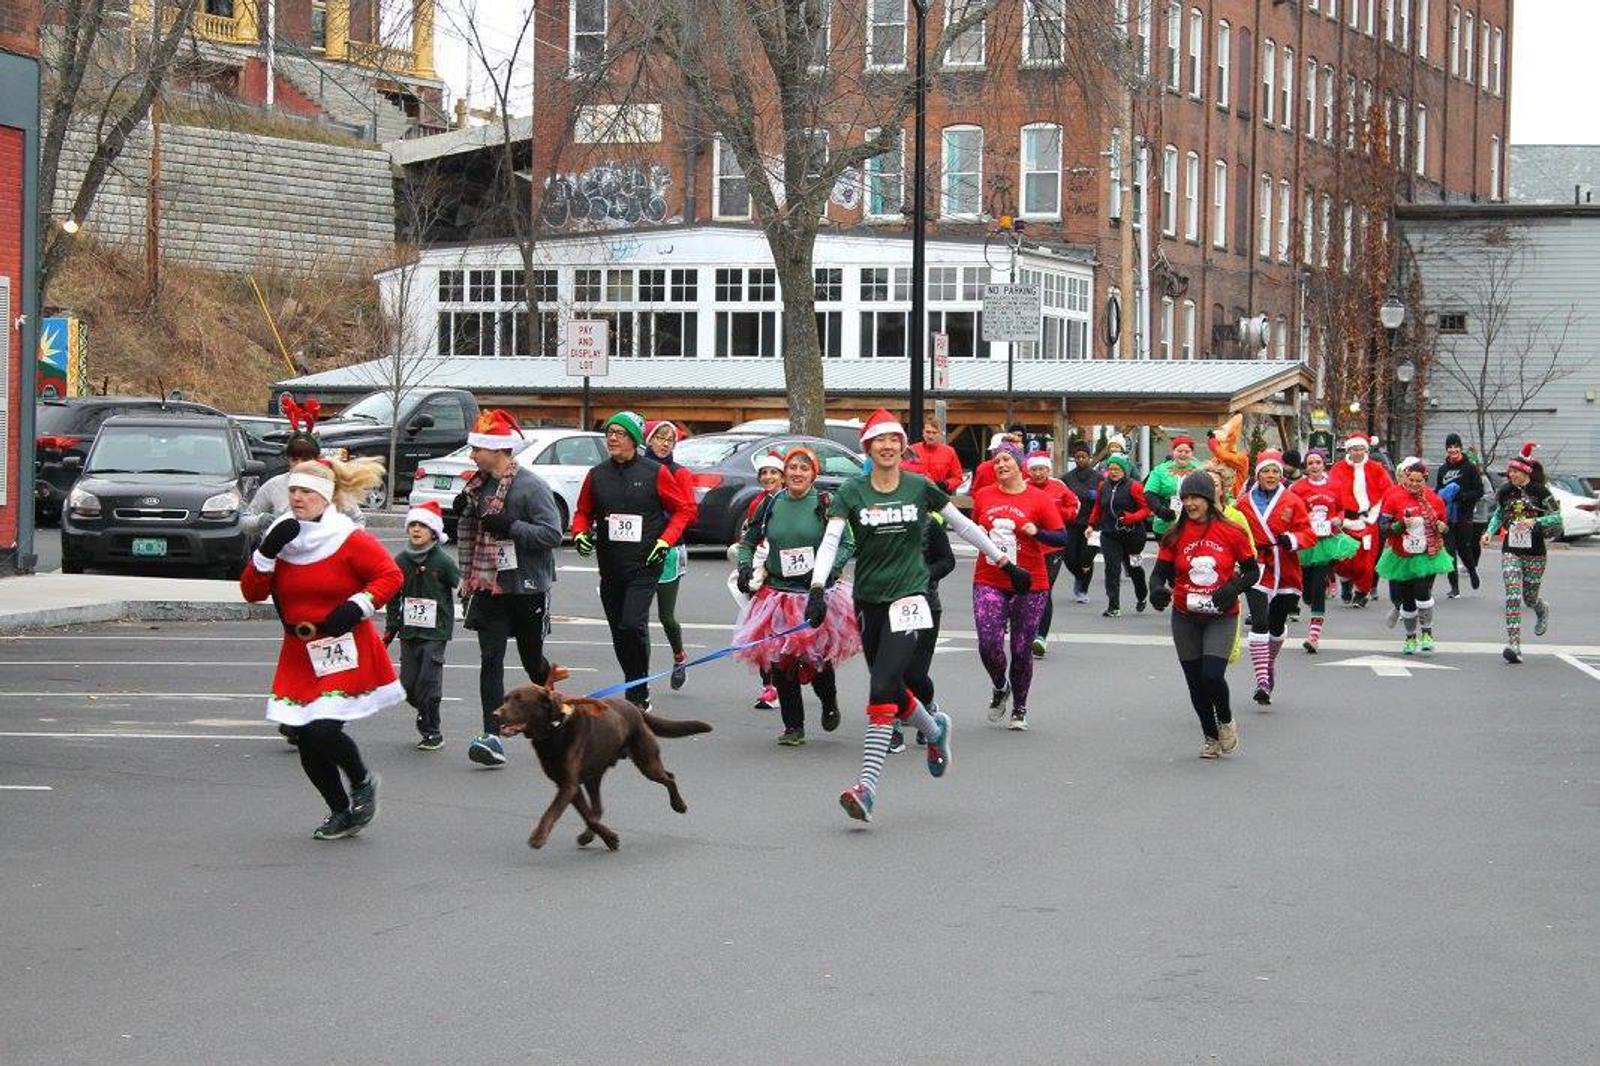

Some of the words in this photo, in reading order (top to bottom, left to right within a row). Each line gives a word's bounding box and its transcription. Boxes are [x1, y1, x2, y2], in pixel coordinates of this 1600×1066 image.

[988, 286, 999, 294] NO
[1004, 286, 1037, 295] PARKING
[579, 326, 592, 334] PAY
[579, 337, 593, 346] AND
[571, 349, 600, 357] DISPLAY
[580, 361, 593, 369] LOT
[860, 507, 902, 526] Santa
[618, 521, 632, 530] 30
[790, 554, 804, 564] 34
[413, 605, 425, 614] 13
[902, 604, 919, 616] 82
[322, 643, 344, 658] 74
